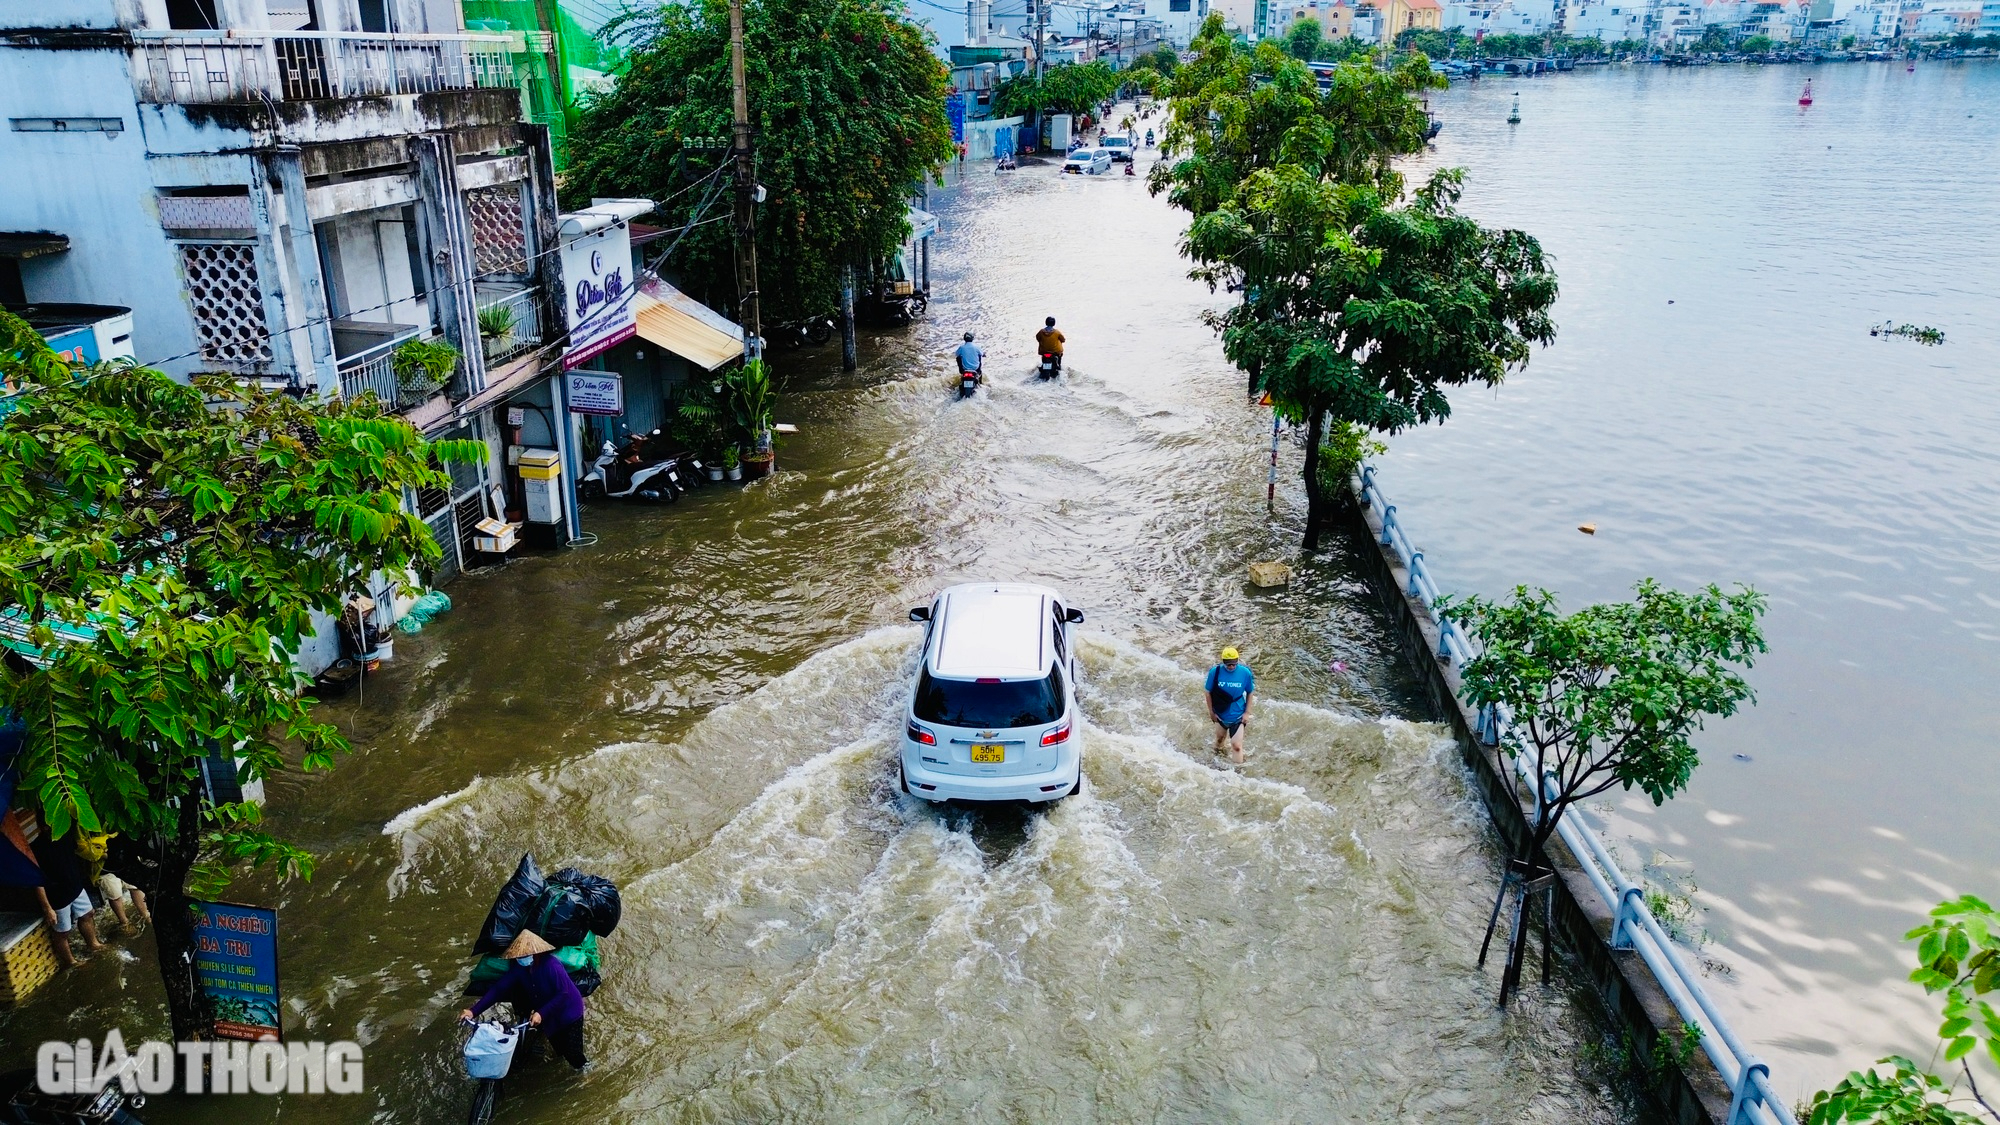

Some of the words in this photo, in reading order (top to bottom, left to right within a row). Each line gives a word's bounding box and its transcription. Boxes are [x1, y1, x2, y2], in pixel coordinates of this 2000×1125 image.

[974, 754, 1001, 762] 495.75
[215, 912, 271, 936] NGHÊU
[198, 935, 222, 954] BA
[224, 938, 252, 958] TRI
